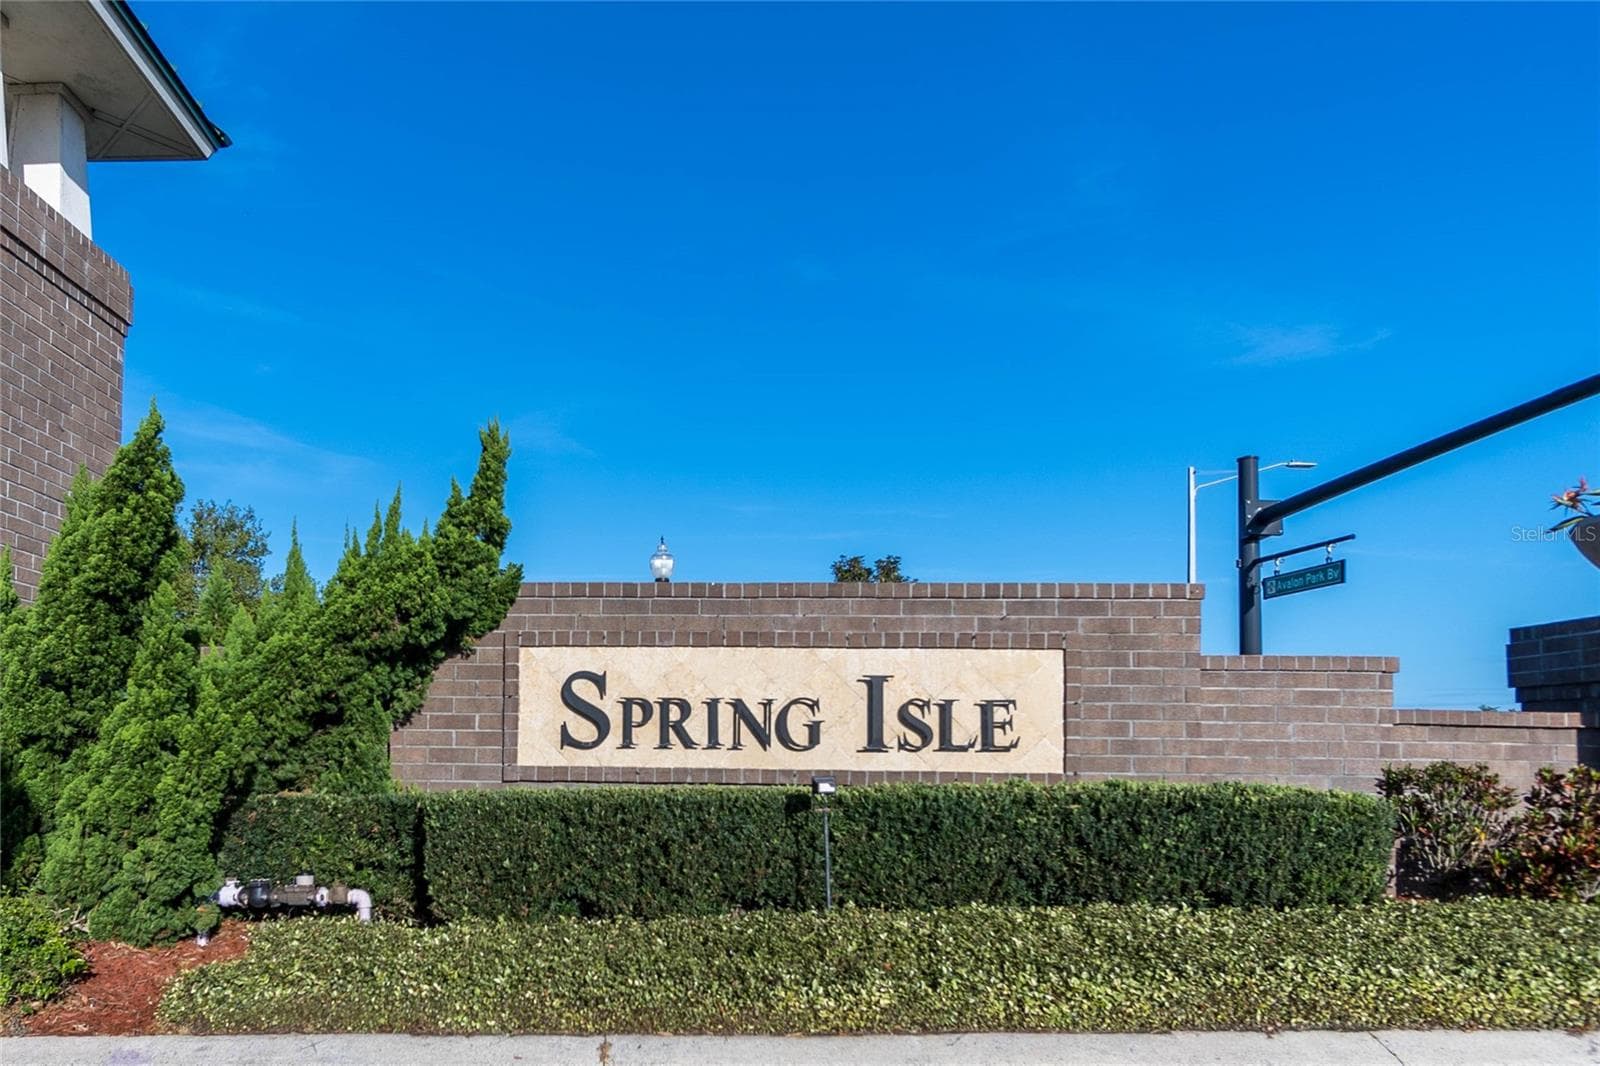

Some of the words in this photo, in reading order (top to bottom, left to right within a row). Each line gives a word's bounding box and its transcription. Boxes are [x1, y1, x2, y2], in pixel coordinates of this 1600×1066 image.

[1277, 577, 1304, 590] Avalon
[1305, 571, 1325, 585] Park
[561, 670, 824, 751] SPRING
[856, 675, 1019, 753] ISLE
